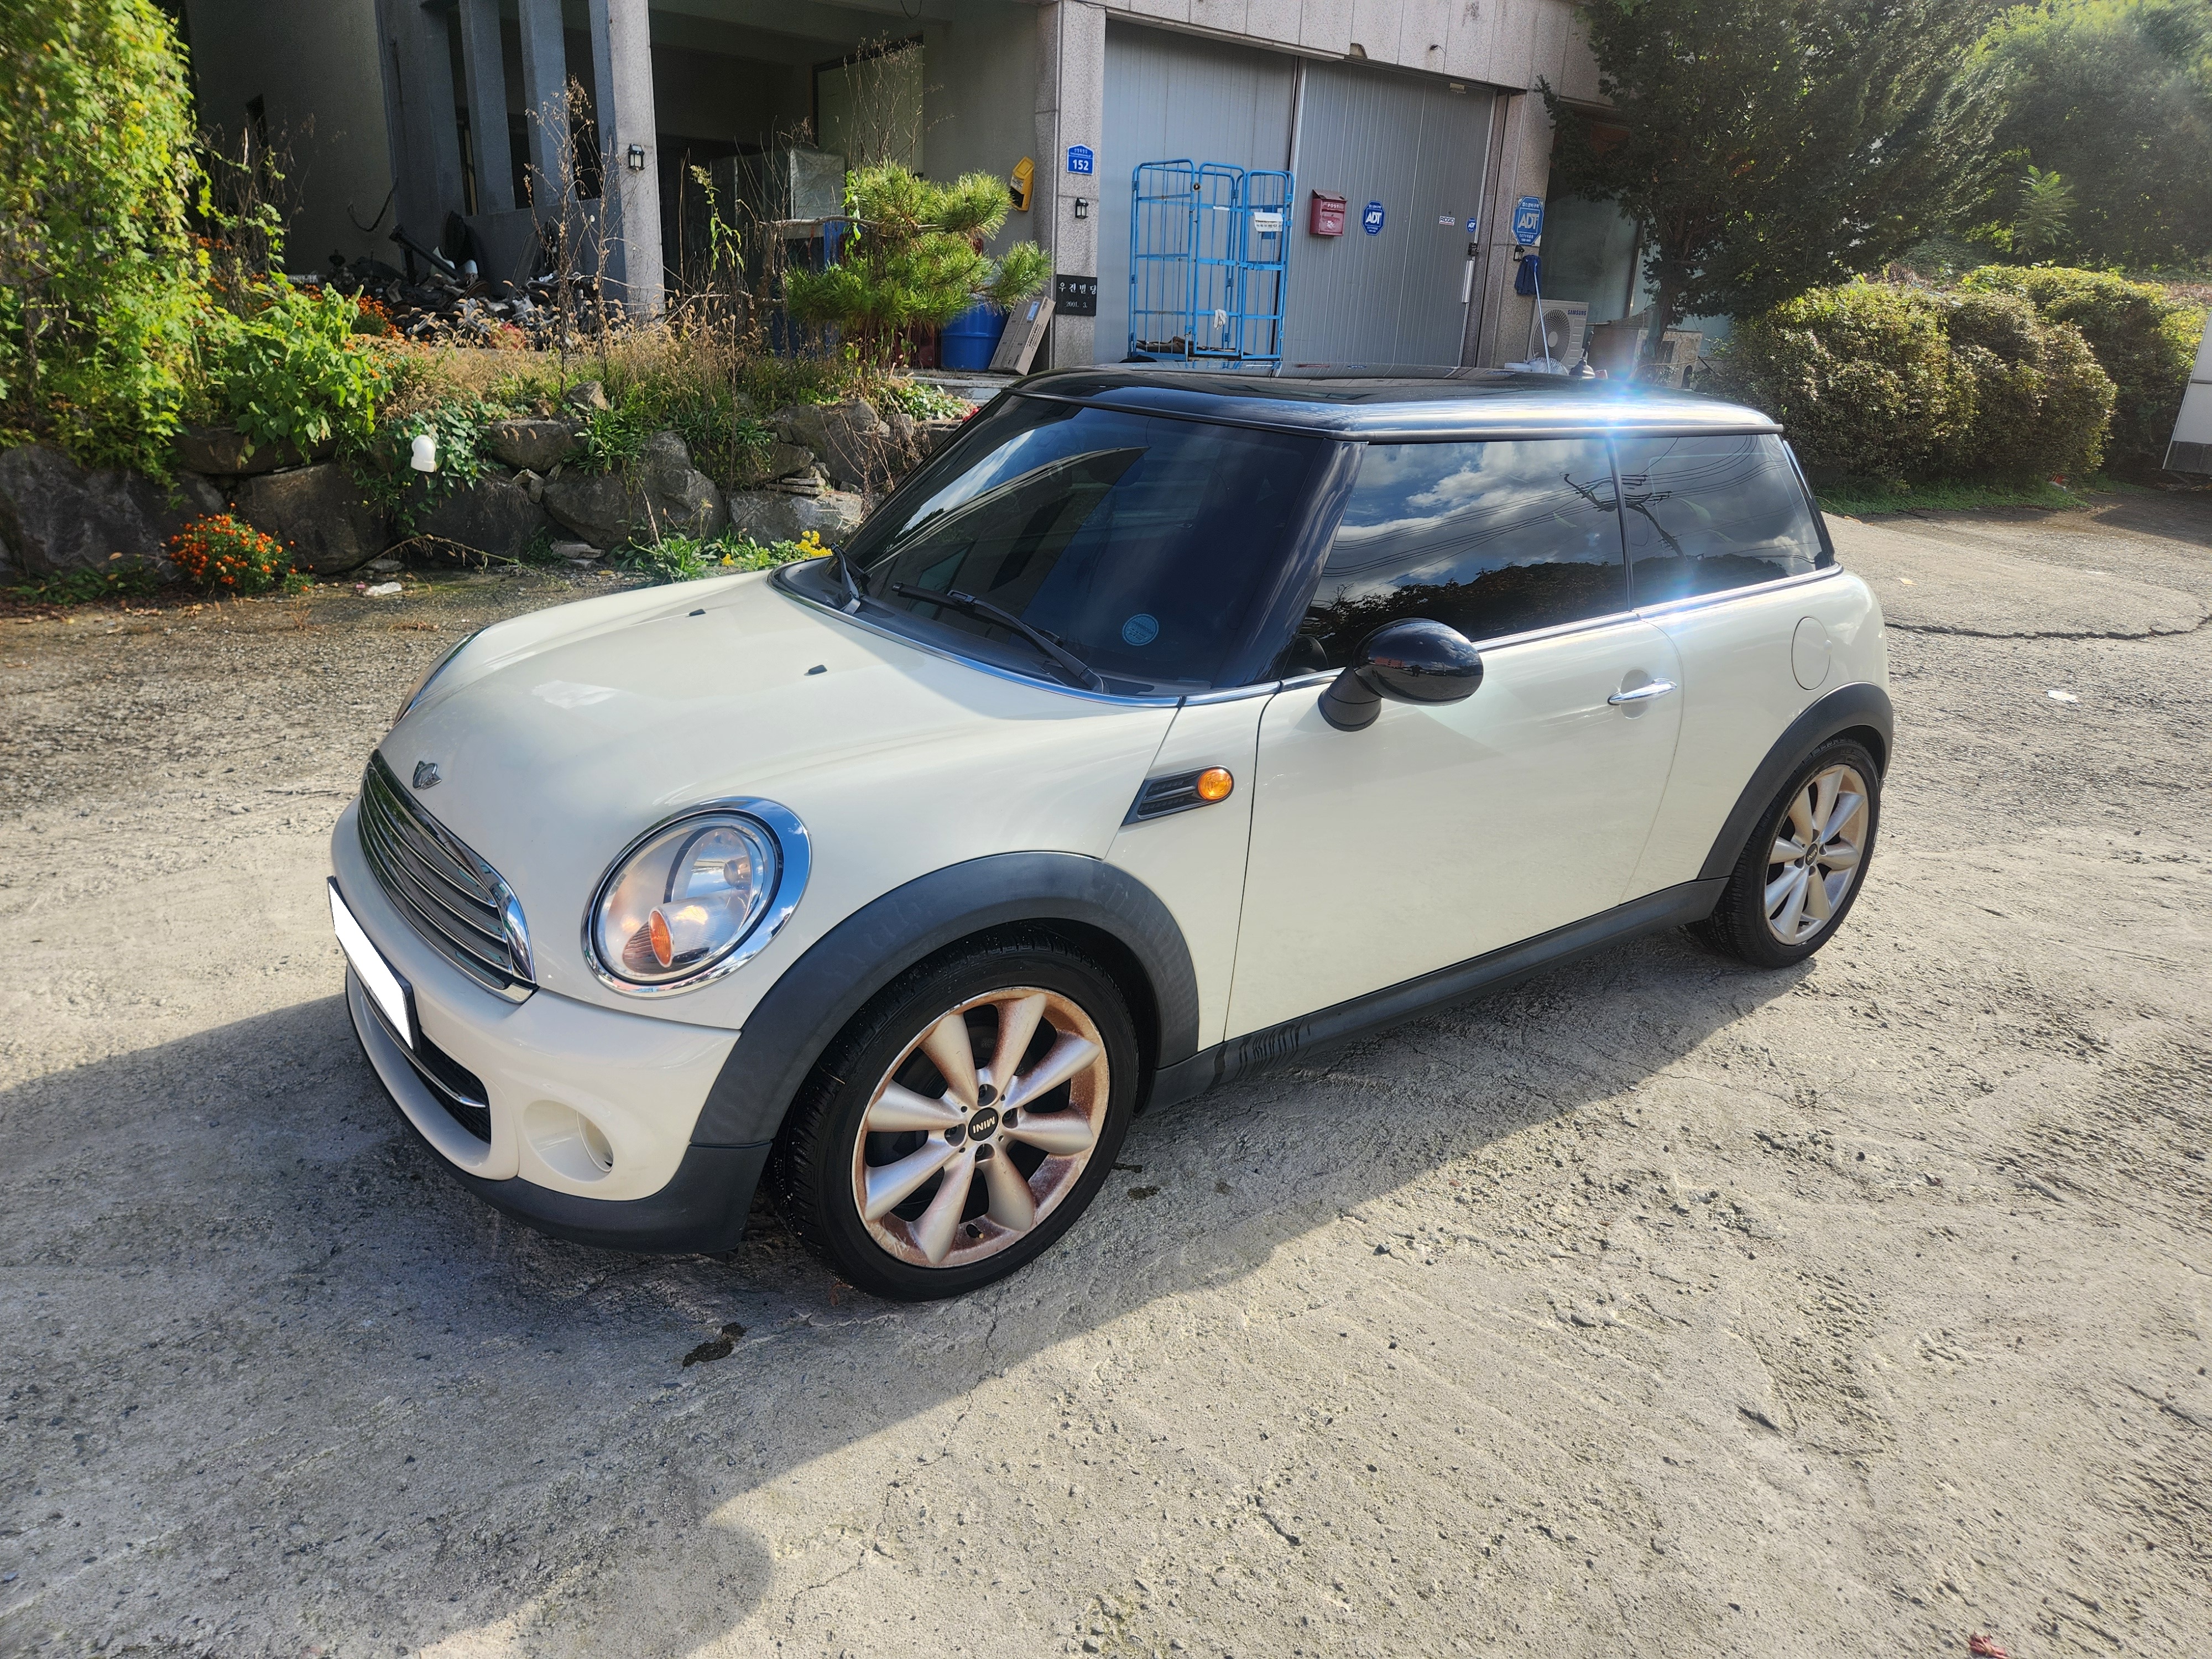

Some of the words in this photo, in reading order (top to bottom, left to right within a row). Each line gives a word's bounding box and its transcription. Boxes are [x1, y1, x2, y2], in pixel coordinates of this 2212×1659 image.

[1072, 159, 1089, 171] 152
[1365, 211, 1382, 225] ADT
[1518, 212, 1539, 229] ADT
[1807, 848, 1817, 861] MINI
[973, 1116, 995, 1134] MINI
